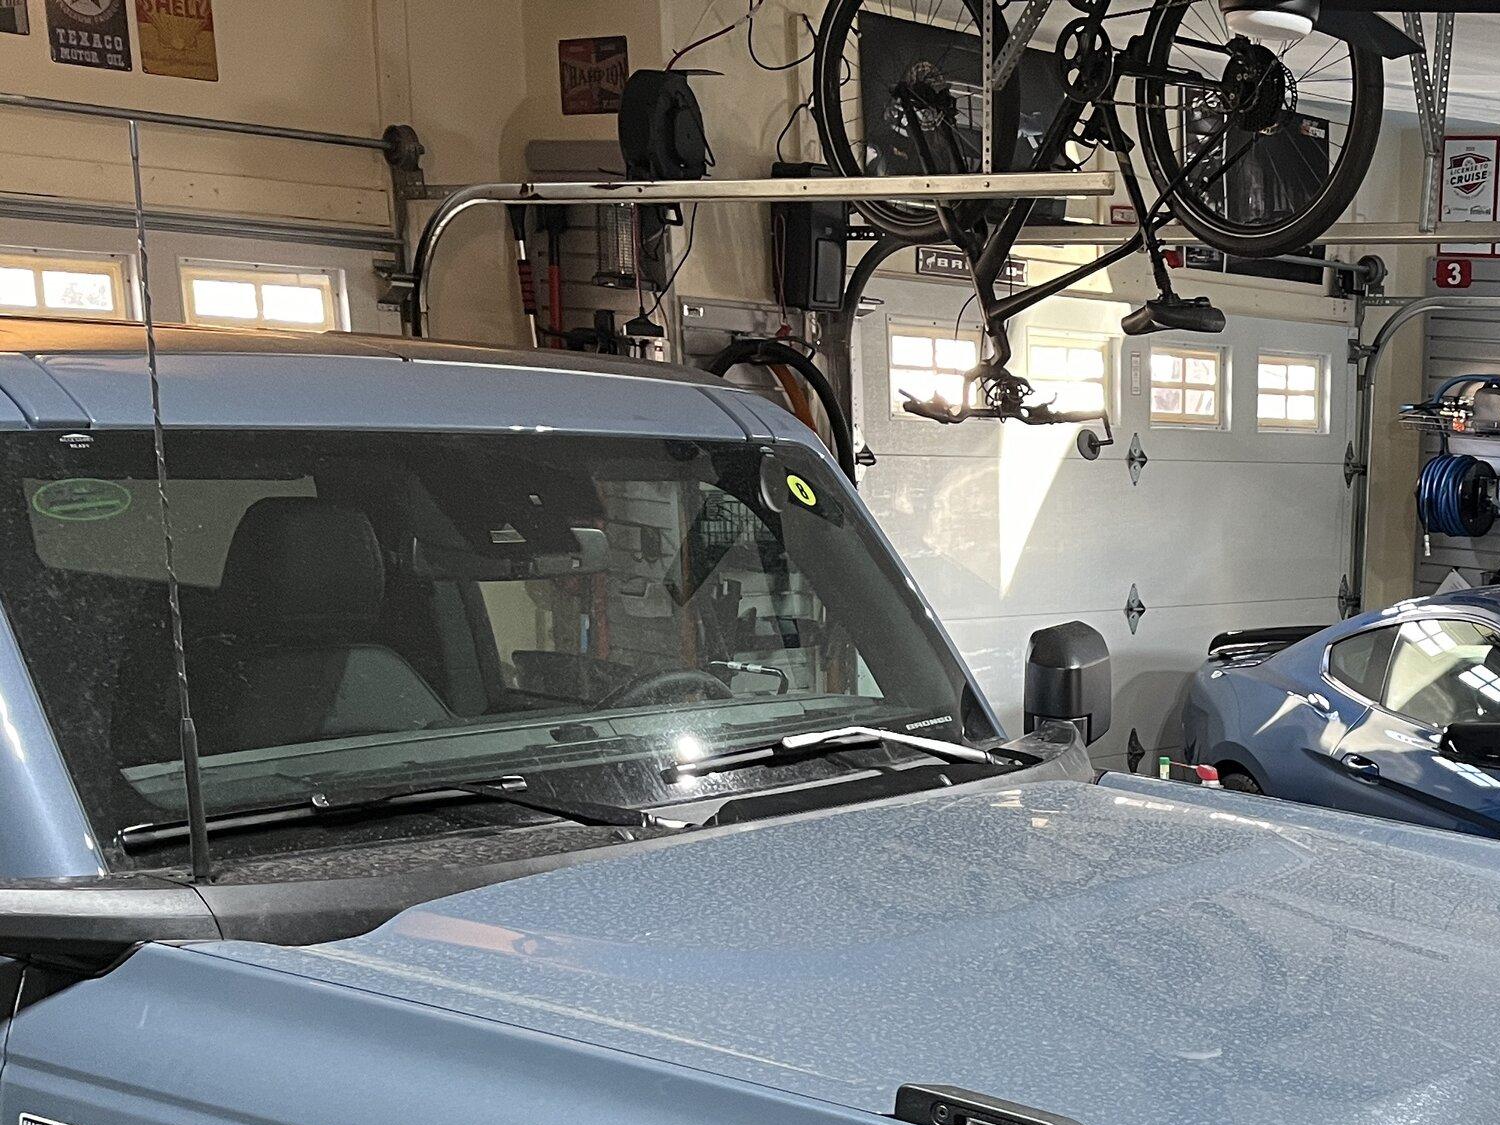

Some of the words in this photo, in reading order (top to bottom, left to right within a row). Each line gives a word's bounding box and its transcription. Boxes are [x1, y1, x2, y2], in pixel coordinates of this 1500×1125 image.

[56, 28, 123, 51] TEXACO
[60, 47, 99, 63] MOTOR
[106, 53, 125, 67] OIL
[1450, 165, 1478, 175] LICENSE
[1450, 170, 1488, 185] CRUISE
[1447, 262, 1461, 285] 3
[905, 715, 953, 731] BRONCO
